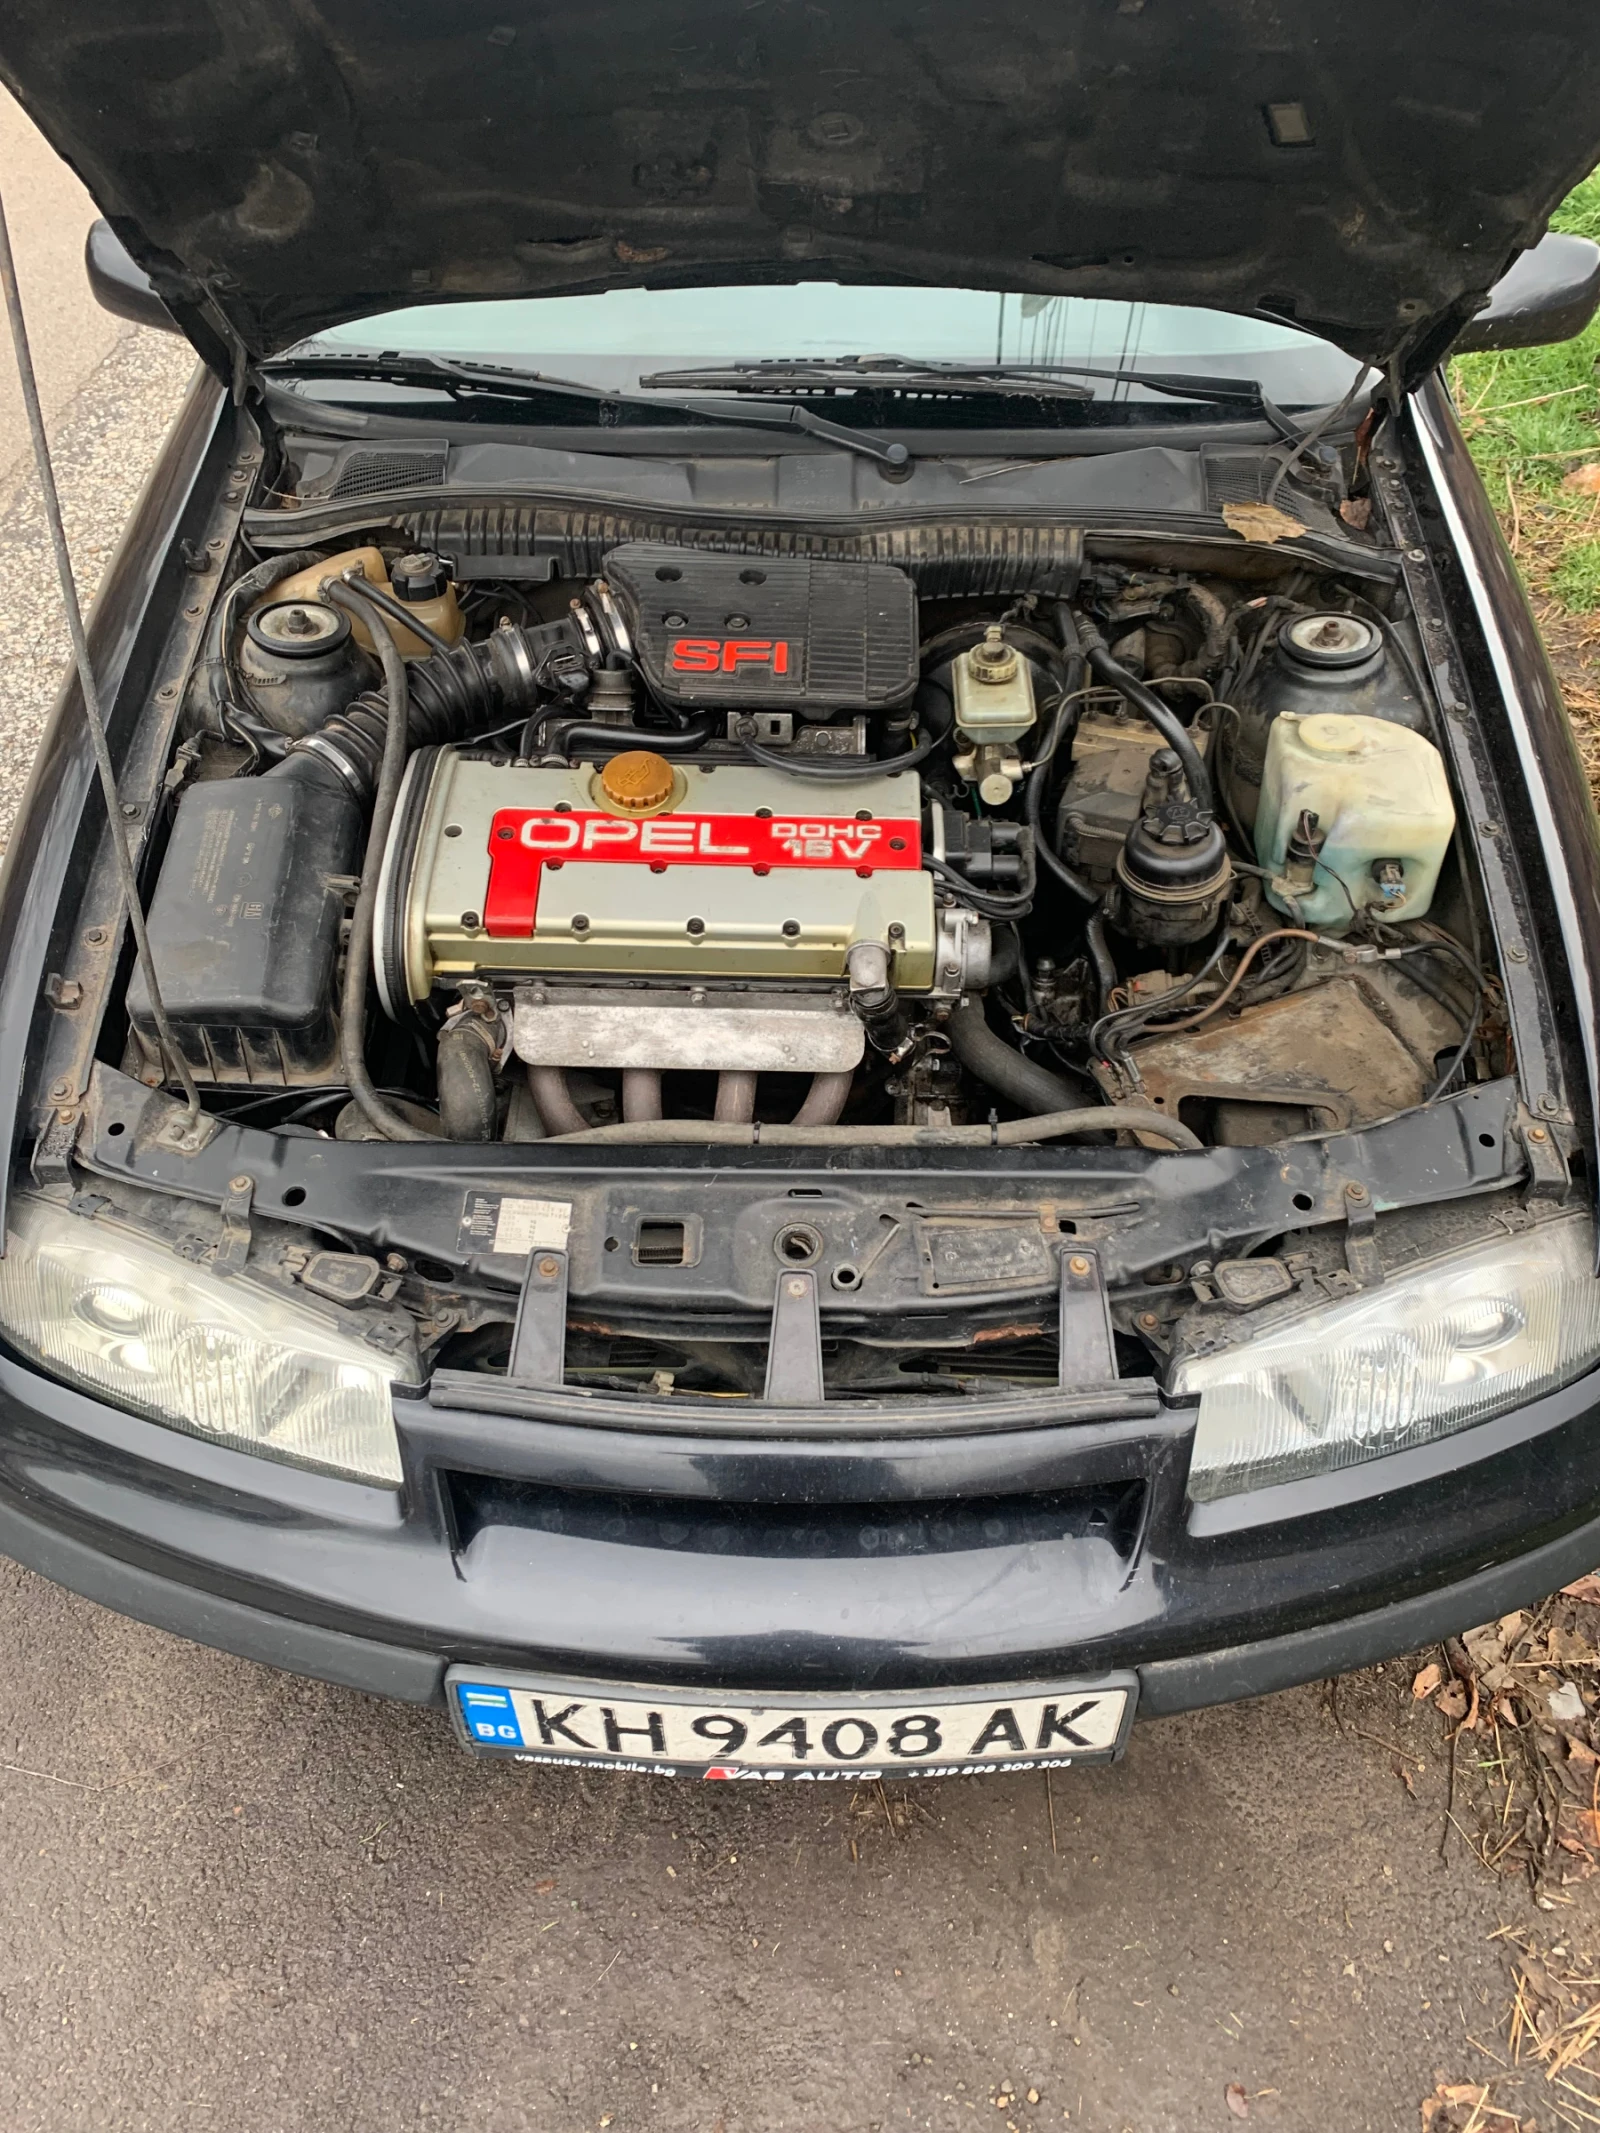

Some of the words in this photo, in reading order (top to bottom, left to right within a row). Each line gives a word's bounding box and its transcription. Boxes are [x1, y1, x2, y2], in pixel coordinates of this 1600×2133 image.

[673, 639, 789, 674] SFI
[520, 817, 750, 857] OPEL
[771, 823, 882, 839] DOHC
[782, 838, 872, 860] 16V
[475, 1723, 517, 1740] BG
[531, 1699, 668, 1757] KH
[691, 1713, 943, 1760] 9408
[967, 1700, 1101, 1755] AK
[514, 1753, 677, 1777] vasauto.mobile.bg
[724, 1769, 786, 1780] VAS
[793, 1770, 883, 1781] AUTO
